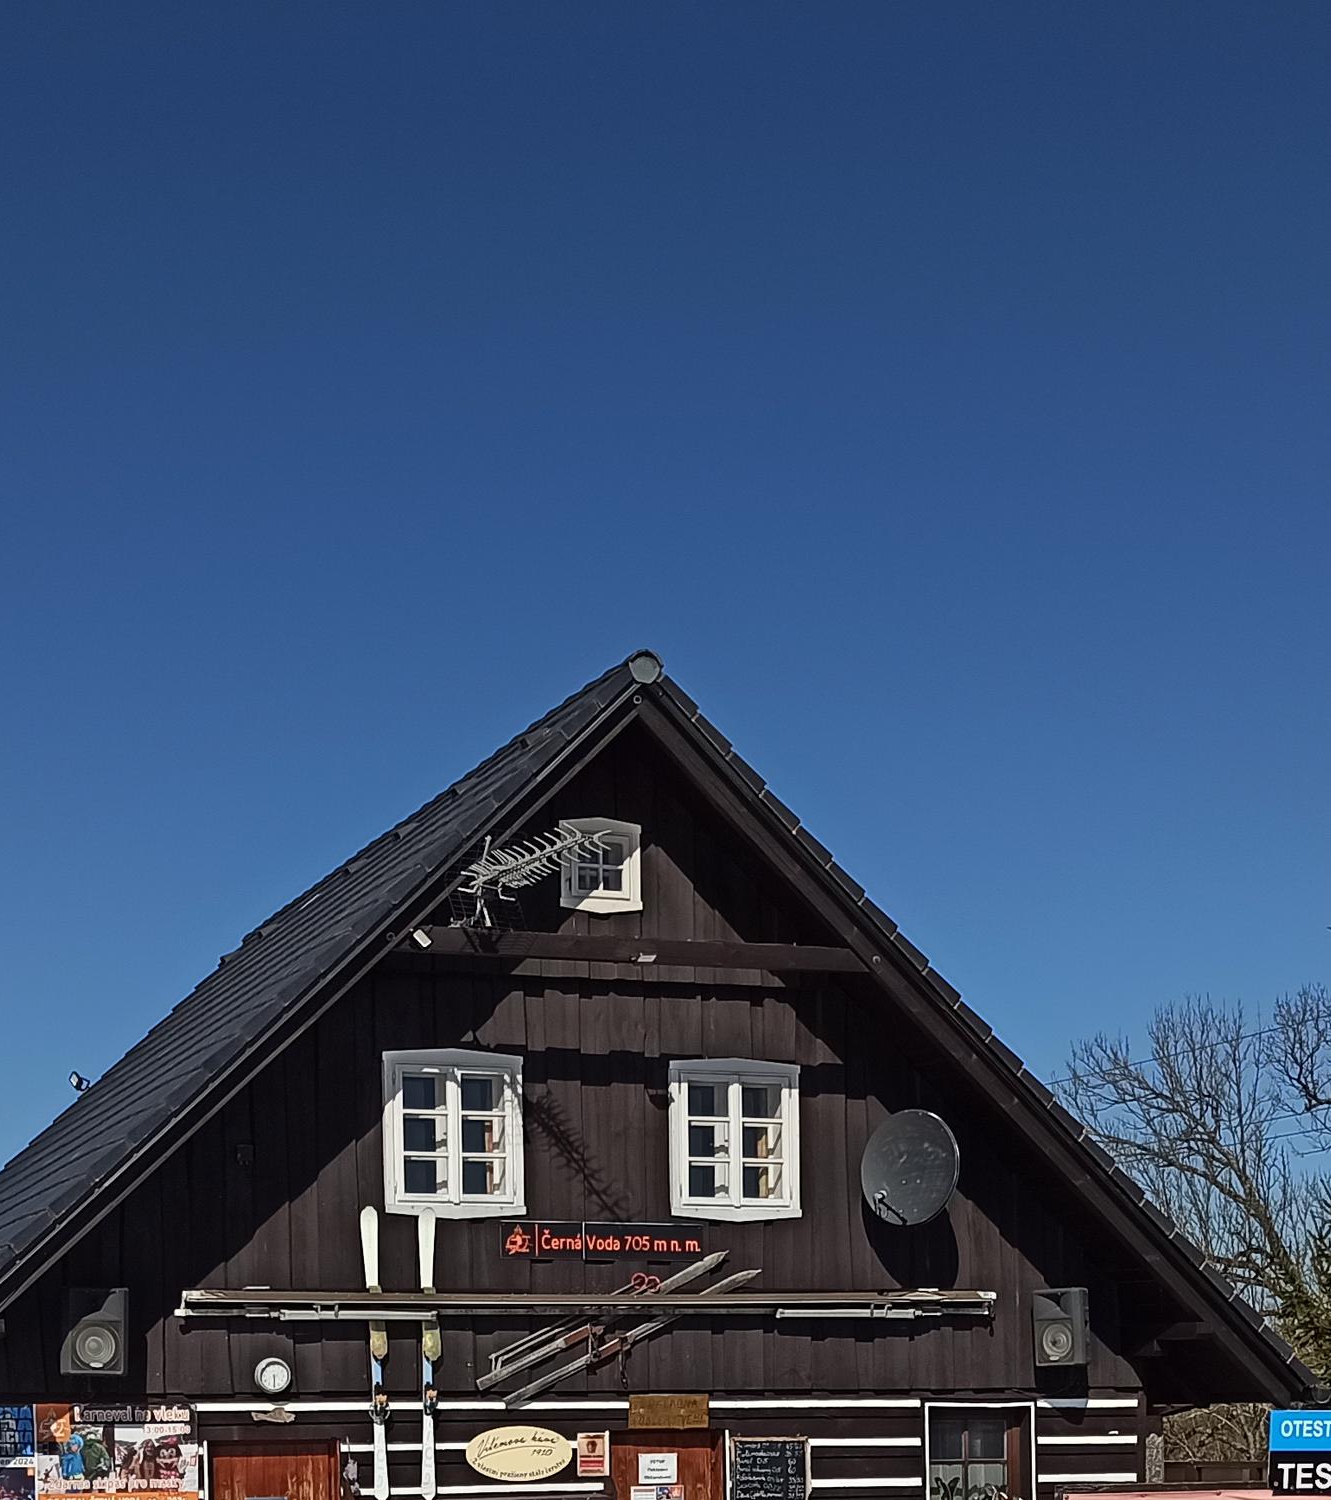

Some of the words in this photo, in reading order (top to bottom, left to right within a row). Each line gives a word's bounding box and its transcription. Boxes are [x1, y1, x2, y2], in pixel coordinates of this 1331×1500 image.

[541, 1228, 582, 1251] Černá
[586, 1234, 621, 1251] Voda
[624, 1235, 651, 1251] 705
[653, 1239, 668, 1251] m
[670, 1239, 683, 1251] n.
[685, 1239, 701, 1252] m.
